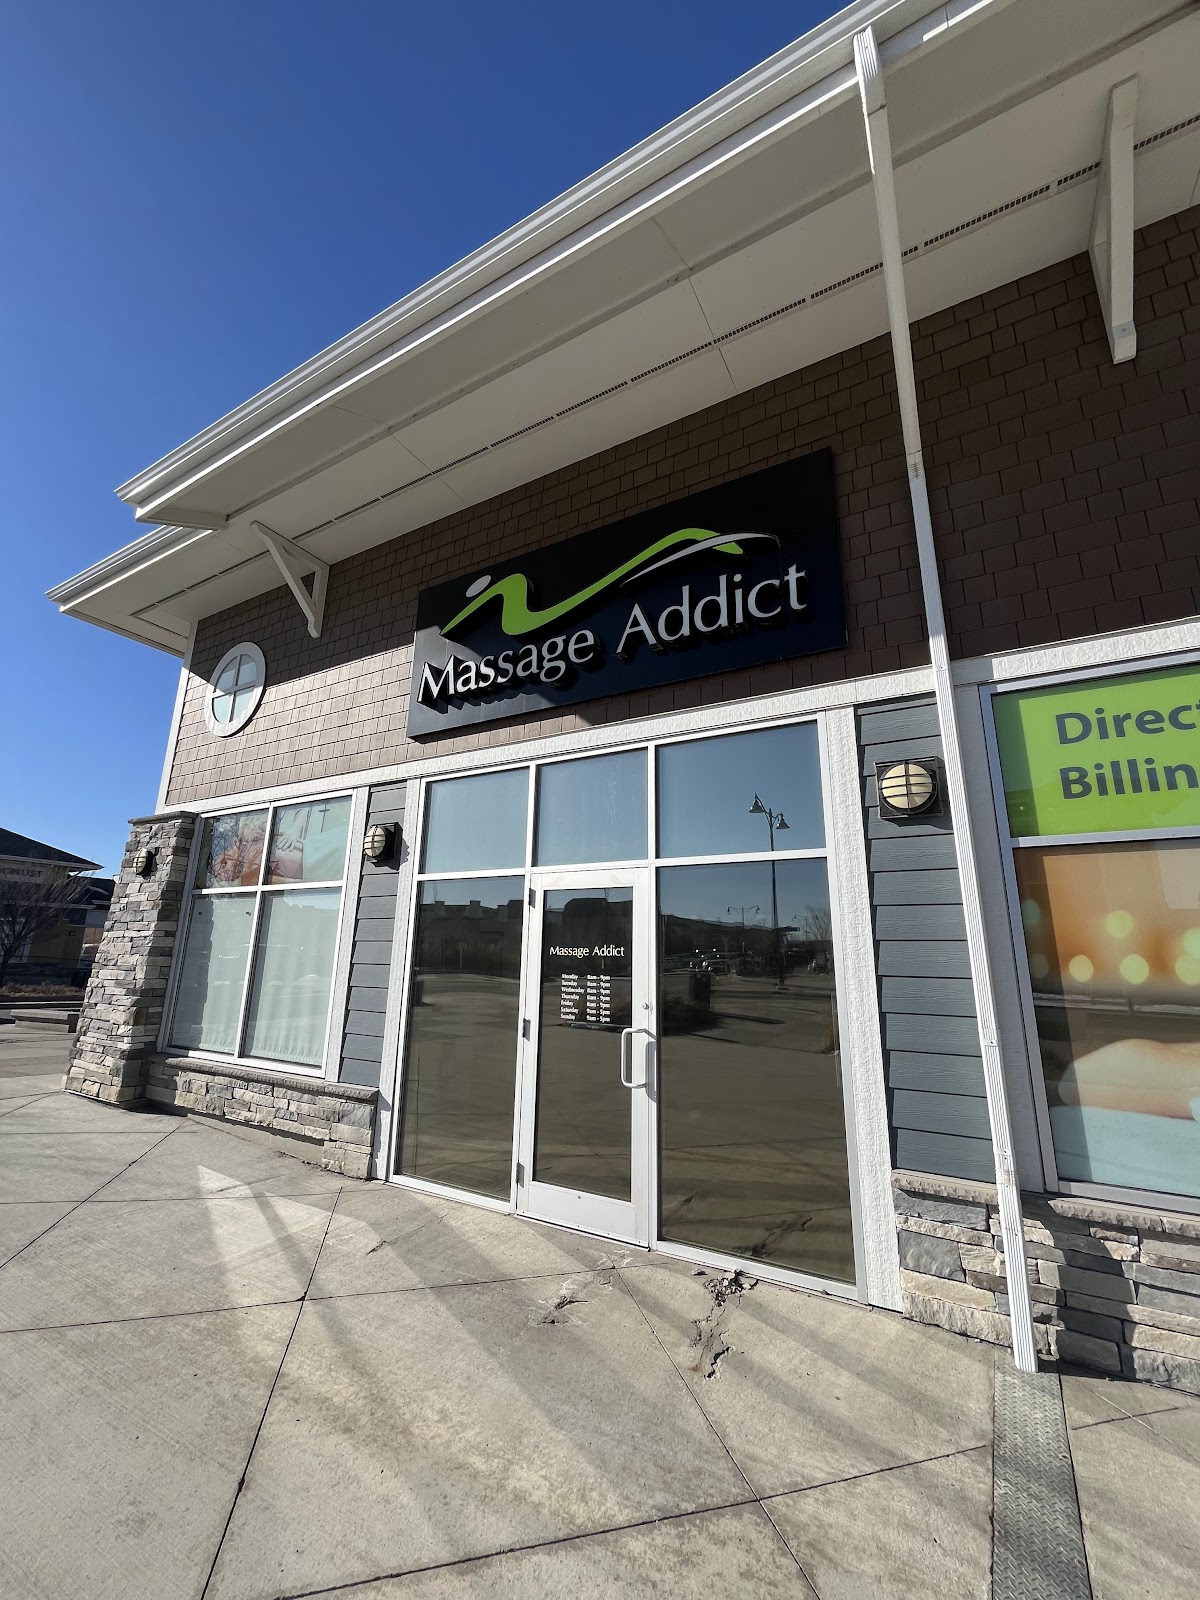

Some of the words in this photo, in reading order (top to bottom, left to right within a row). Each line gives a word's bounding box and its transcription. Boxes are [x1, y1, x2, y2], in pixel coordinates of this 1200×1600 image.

[417, 629, 595, 703] Massage
[615, 563, 807, 656] Addict
[549, 945, 589, 959] Massage
[592, 944, 625, 957] Addict
